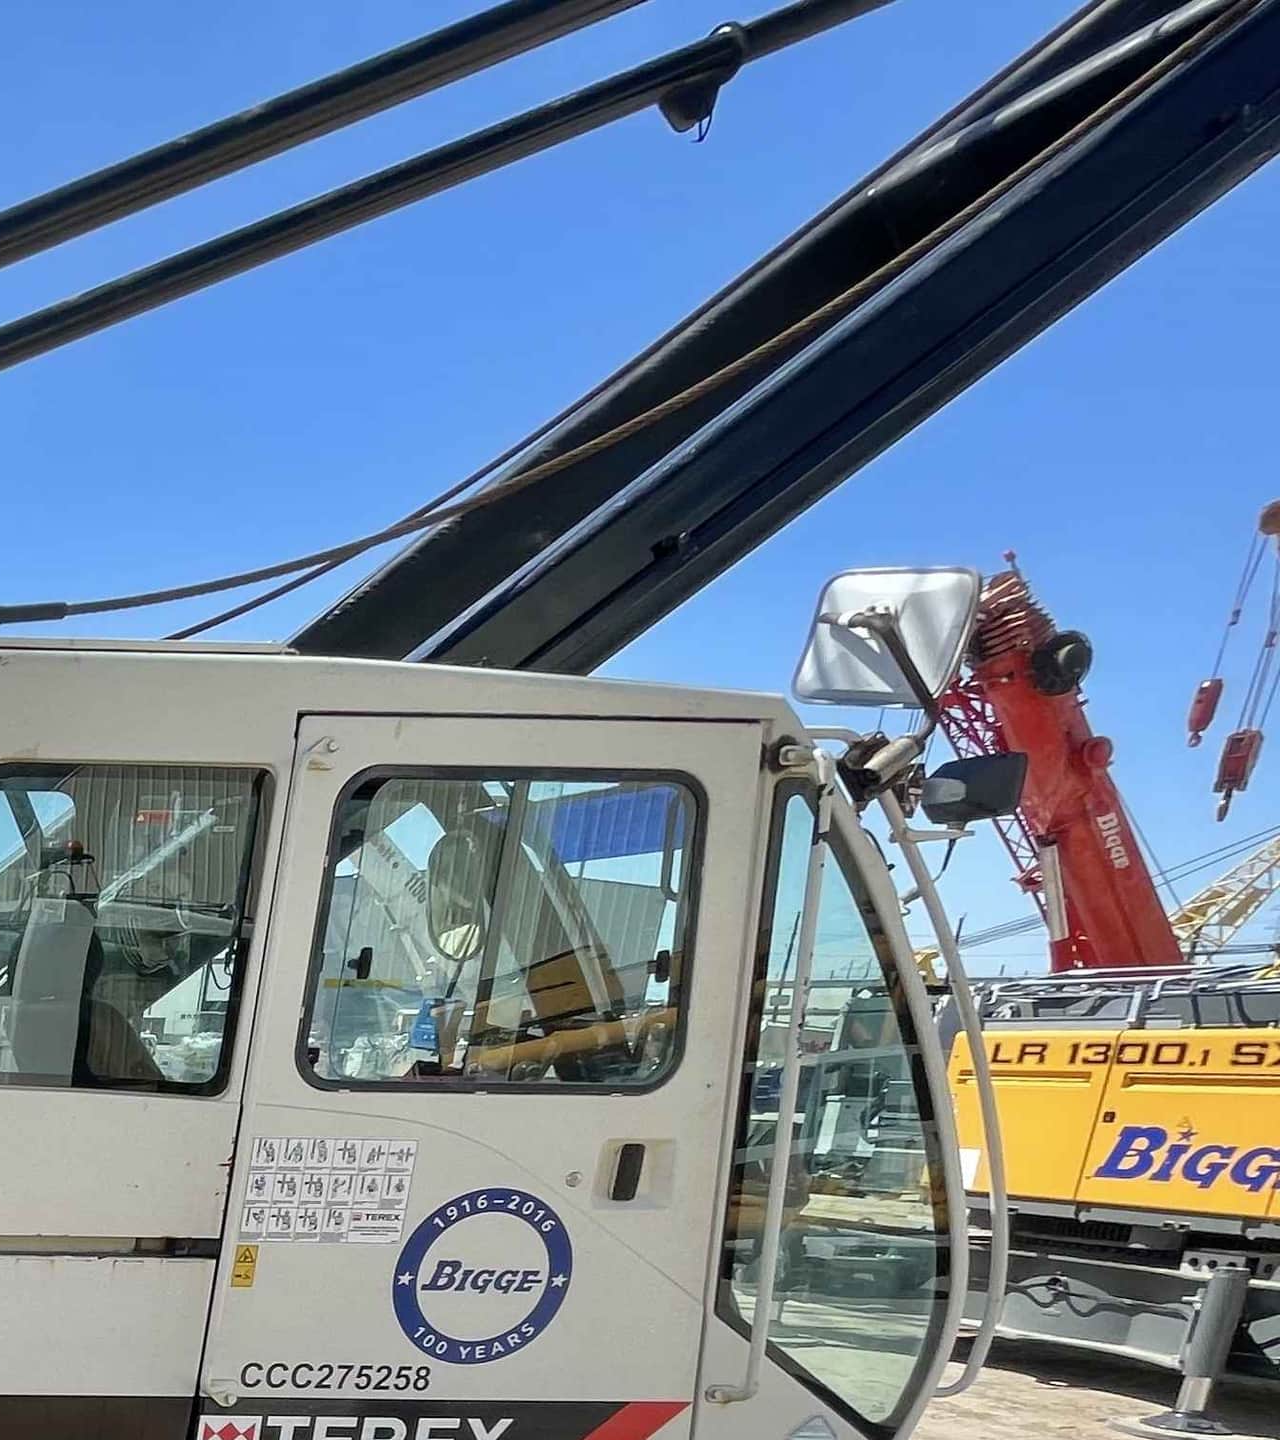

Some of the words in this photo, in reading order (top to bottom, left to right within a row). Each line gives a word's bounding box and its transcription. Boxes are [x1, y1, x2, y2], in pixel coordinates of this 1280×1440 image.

[990, 1043, 1049, 1064] LR
[1095, 1126, 1280, 1192] BIGG
[433, 1195, 556, 1233] 1916-2016
[421, 1260, 543, 1294] BIGGE
[413, 1327, 447, 1354] 100
[459, 1322, 536, 1360] YEARS
[240, 1362, 431, 1391] CCC275258
